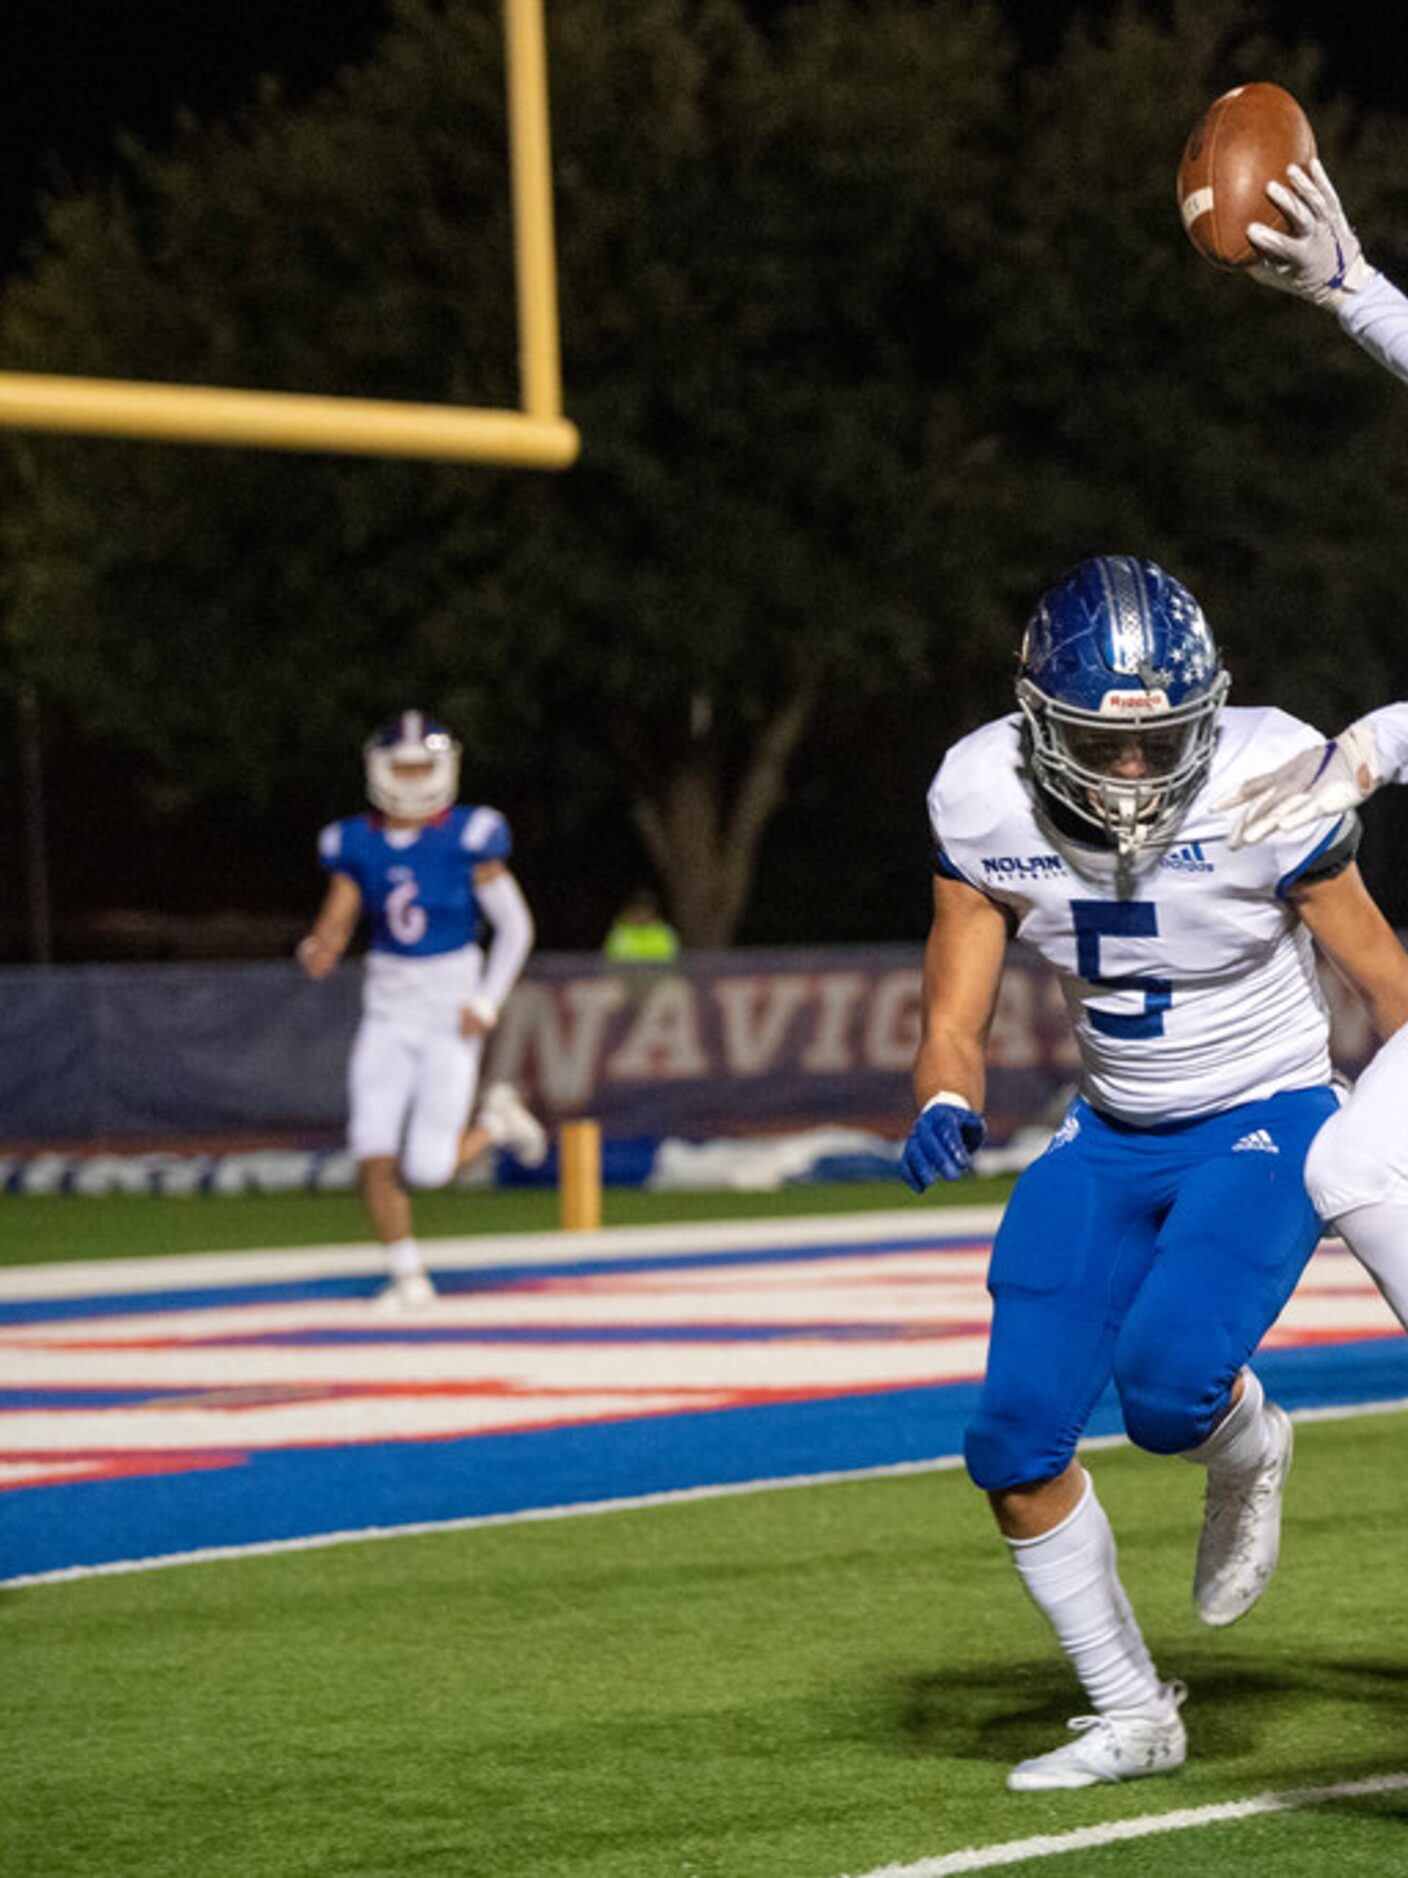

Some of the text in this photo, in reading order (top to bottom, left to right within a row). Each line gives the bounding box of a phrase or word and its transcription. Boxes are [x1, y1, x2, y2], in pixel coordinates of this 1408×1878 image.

[981, 854, 1062, 874] NOLAN
[384, 879, 429, 947] 6
[1068, 900, 1173, 1039] 5
